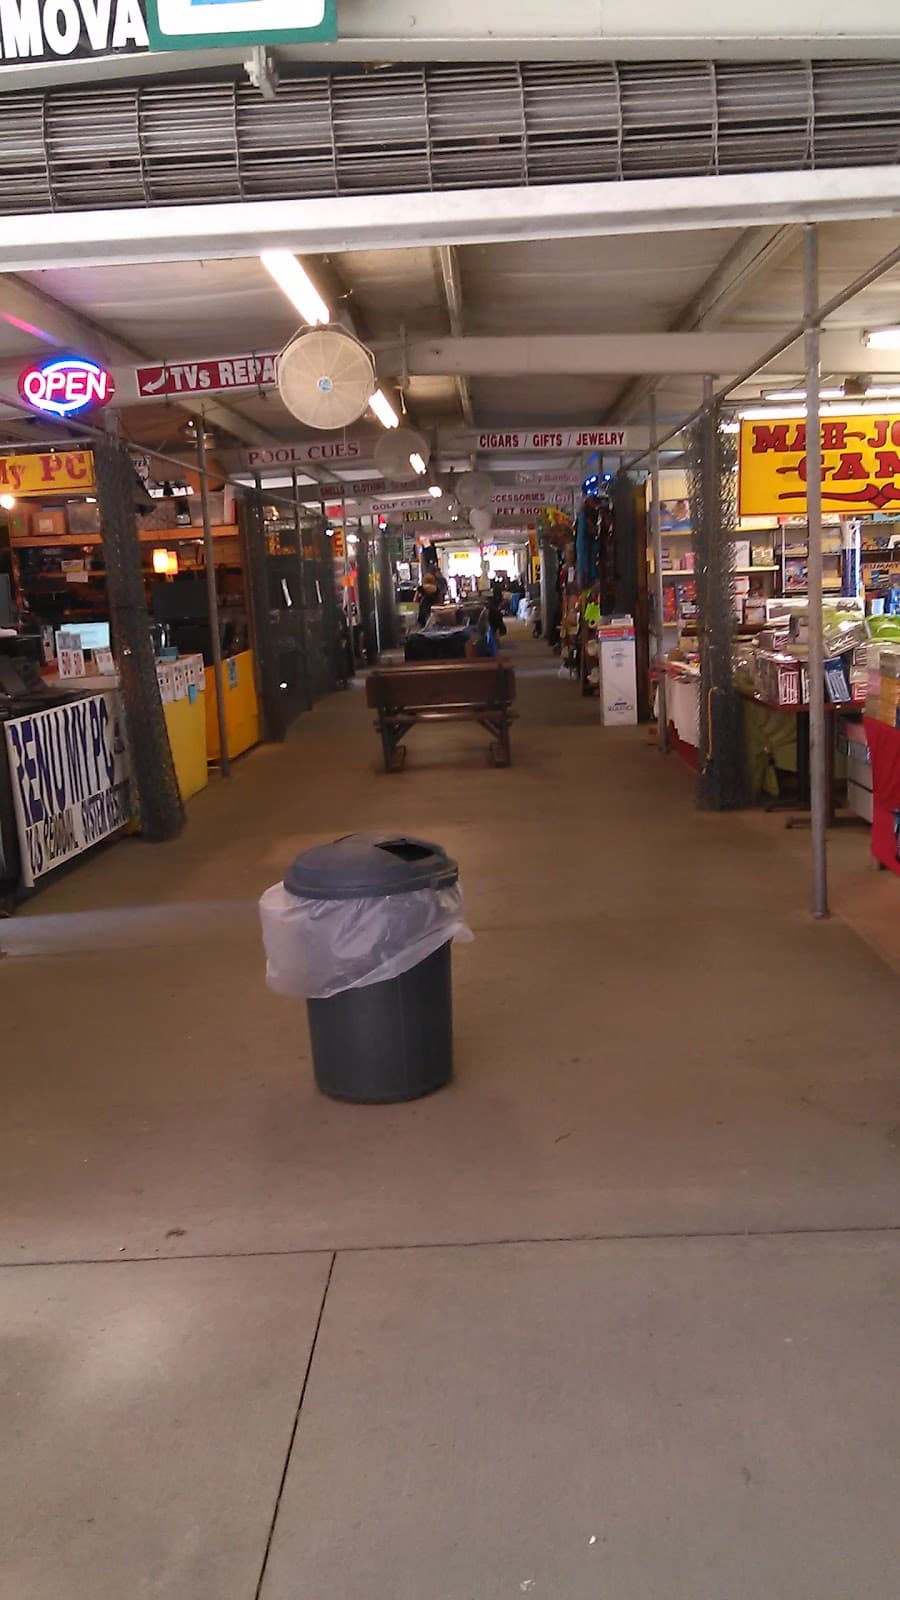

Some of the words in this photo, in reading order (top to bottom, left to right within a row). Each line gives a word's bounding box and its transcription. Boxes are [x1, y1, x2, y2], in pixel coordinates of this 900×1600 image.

[0, 0, 150, 58] MOVA
[23, 371, 106, 401] OPEN
[169, 364, 211, 391] TVs
[479, 433, 519, 448] CIGARS
[532, 433, 562, 447] GIFTS
[576, 431, 625, 446] JEWELRY
[247, 448, 301, 466] POOL
[307, 441, 359, 460] CUES
[40, 452, 87, 483] PC
[519, 506, 545, 515] SHO
